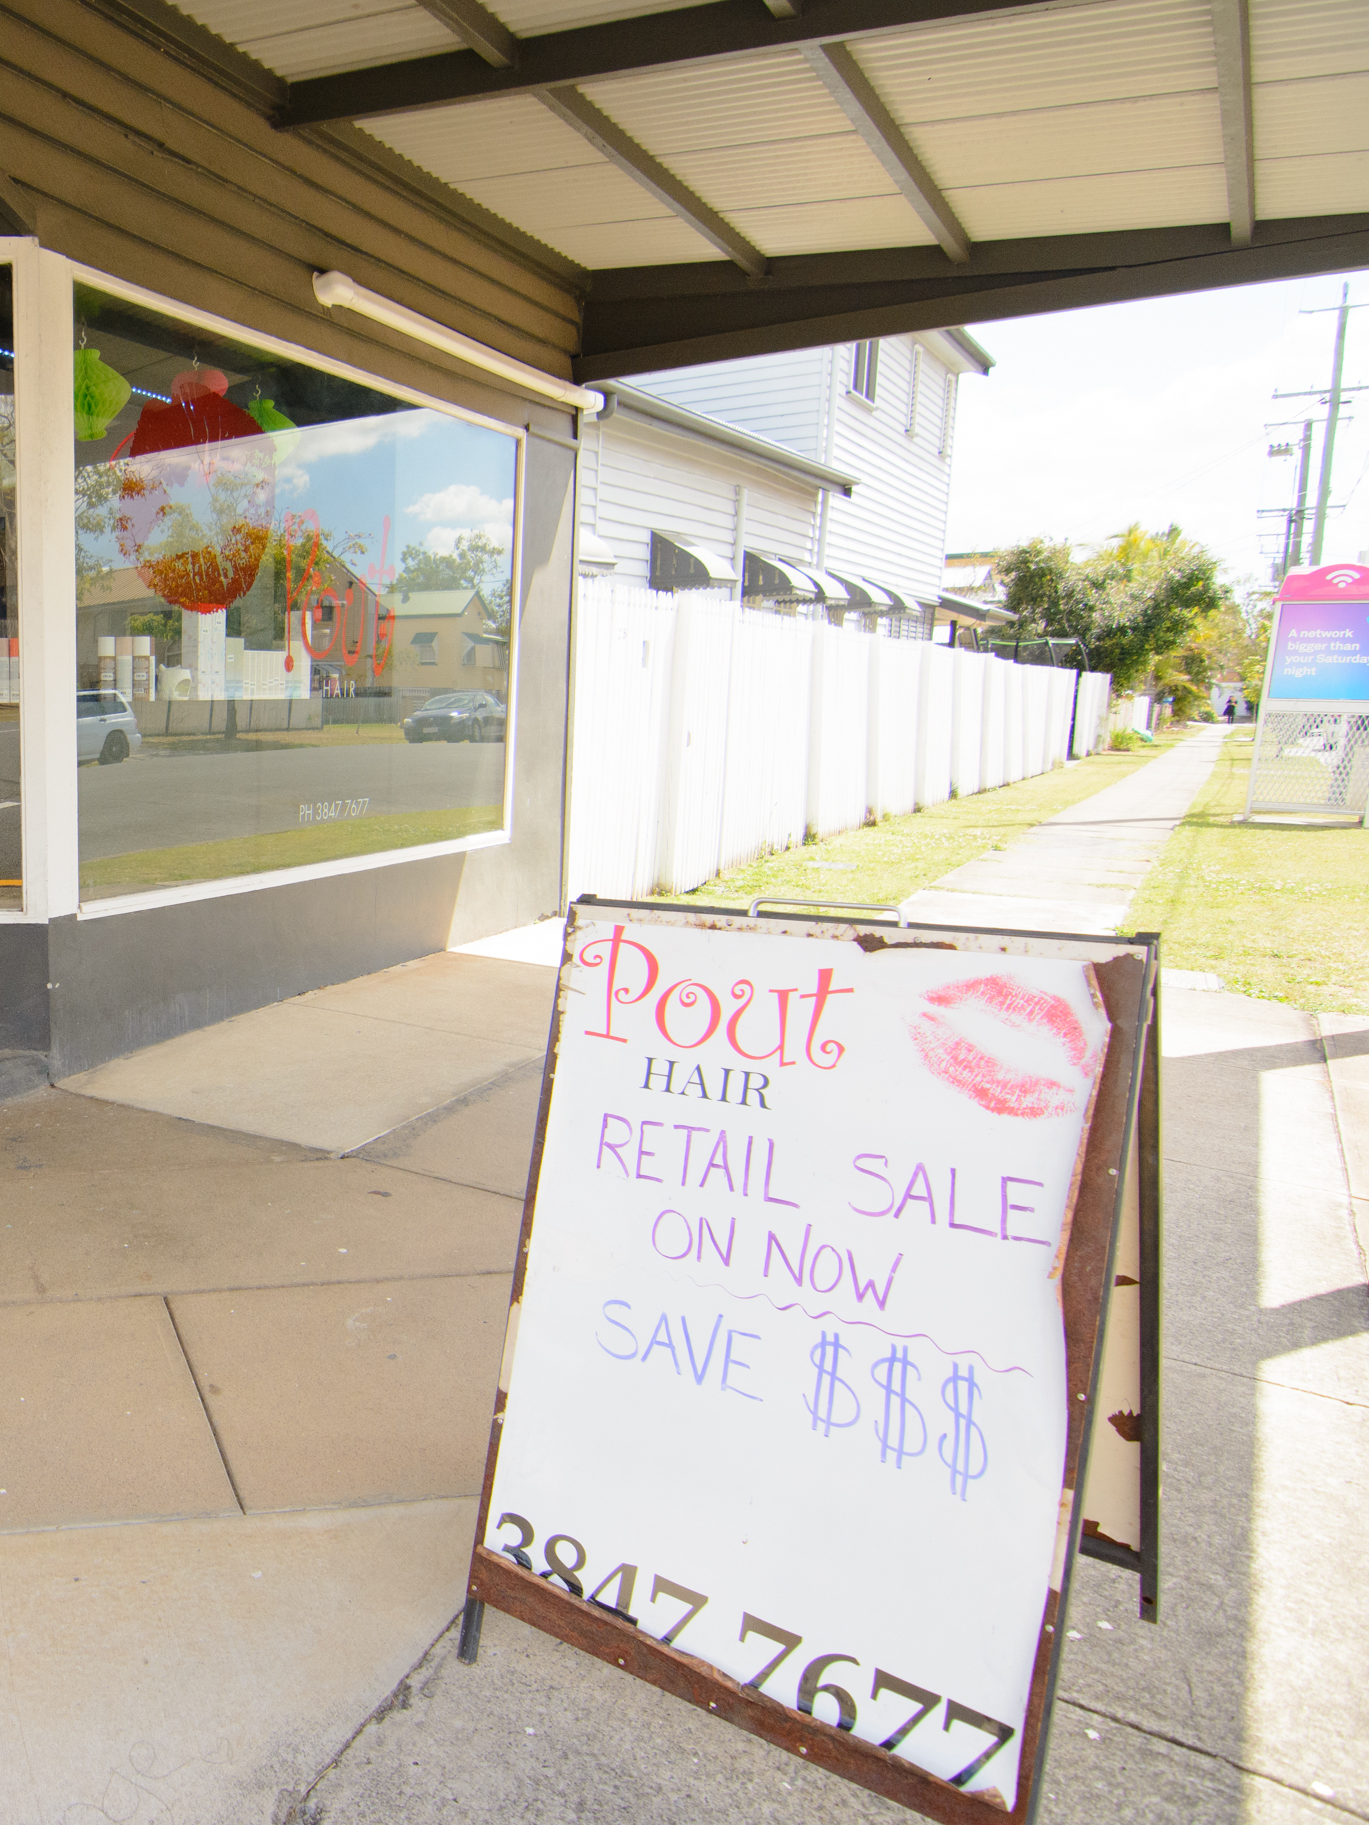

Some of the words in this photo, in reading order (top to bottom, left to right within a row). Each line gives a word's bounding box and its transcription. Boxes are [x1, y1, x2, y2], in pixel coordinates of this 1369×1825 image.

[283, 508, 396, 678] Pout
[1284, 655, 1314, 665] your
[1286, 641, 1328, 653] bigger
[1329, 641, 1360, 651] than
[1287, 628, 1298, 638] A
[1299, 628, 1354, 638] network
[322, 680, 357, 699] HAIR
[1283, 666, 1317, 678] night
[299, 803, 313, 822] PH
[315, 800, 342, 821] 3847
[344, 797, 370, 817] 7677
[579, 924, 855, 1070] Pout
[639, 1056, 772, 1111] HAIR
[596, 1112, 800, 1208] RETAIL
[848, 1152, 1051, 1247] SALE
[651, 1208, 736, 1267] ON
[763, 1223, 904, 1311] NOW
[595, 1299, 763, 1402] SAVE
[802, 1330, 989, 1502] $$$
[496, 1512, 709, 1646] 3847
[738, 1611, 1016, 1788] 7677
